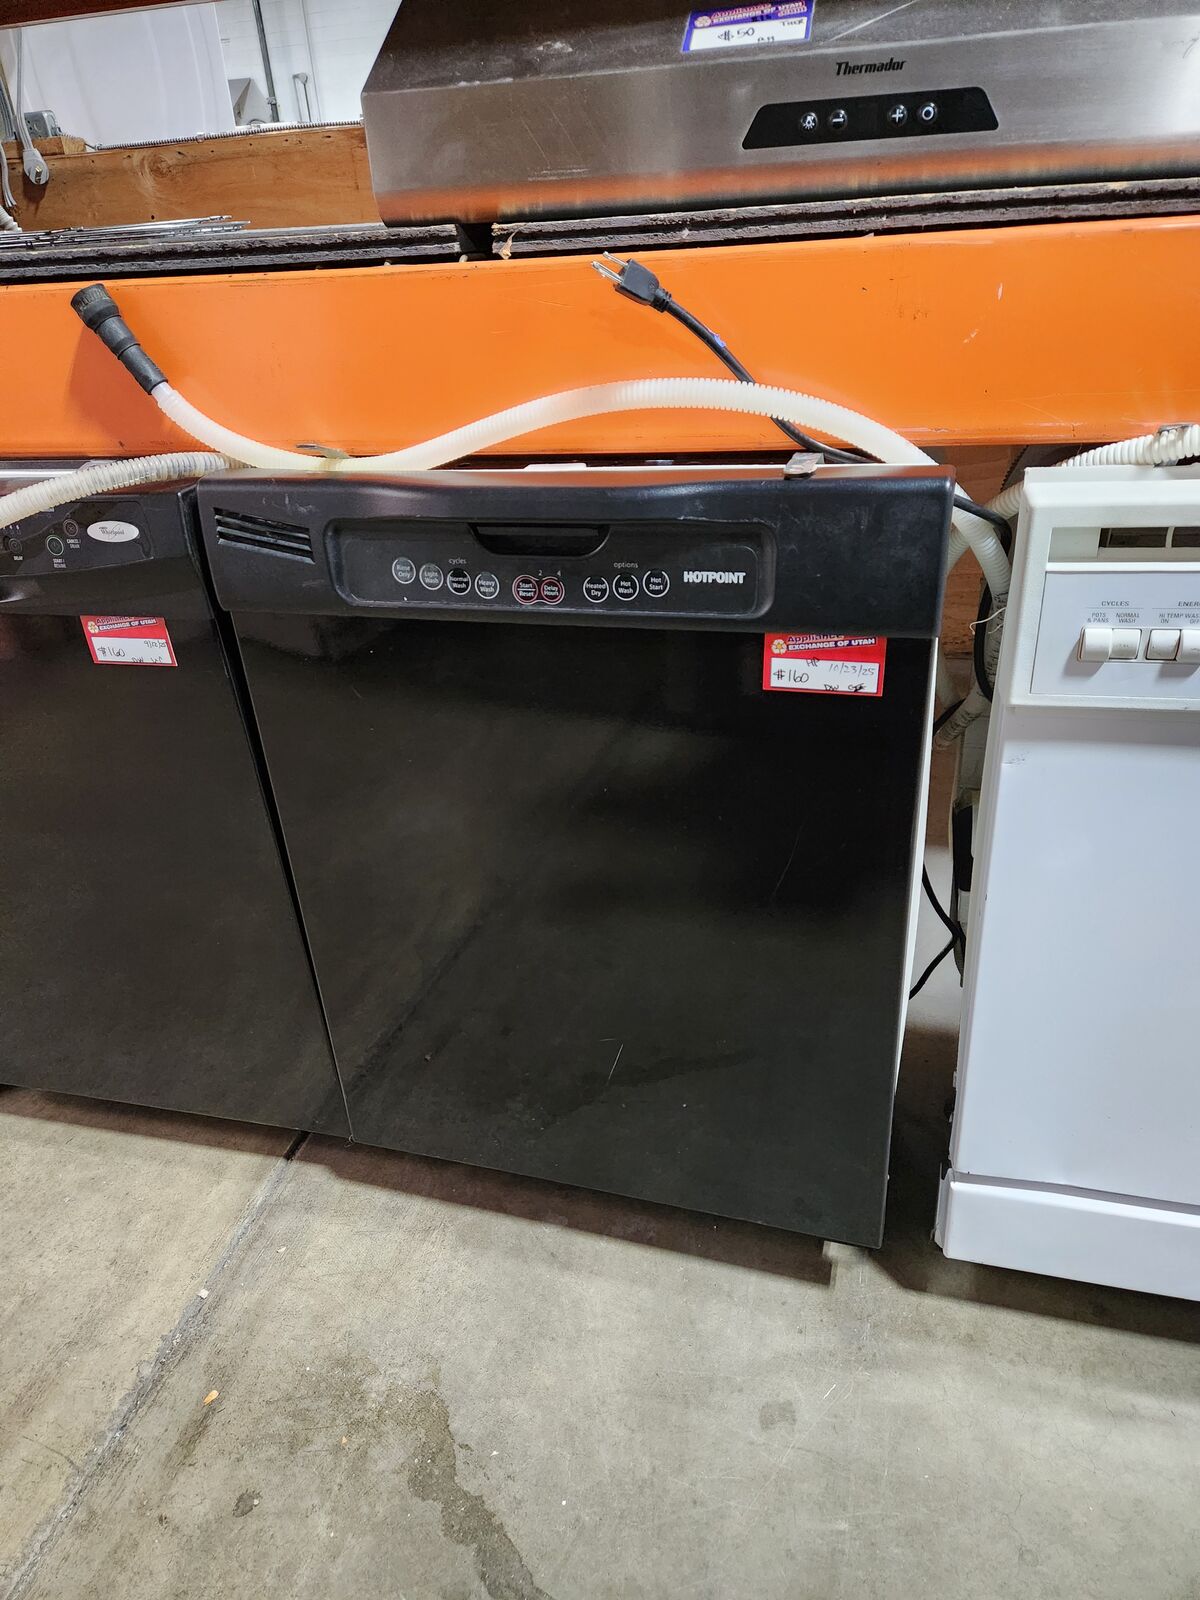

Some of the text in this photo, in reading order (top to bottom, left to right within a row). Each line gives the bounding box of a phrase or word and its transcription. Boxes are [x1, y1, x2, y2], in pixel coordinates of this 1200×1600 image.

[836, 57, 907, 76] Thermador
[683, 571, 746, 584] HOTPOINT
[99, 622, 130, 631] EXCHANGE
[97, 646, 126, 657] $160
[788, 642, 835, 651] EXCHANGE
[806, 657, 820, 668] HP
[828, 662, 876, 677] 10/23/25
[773, 669, 810, 683] $160
